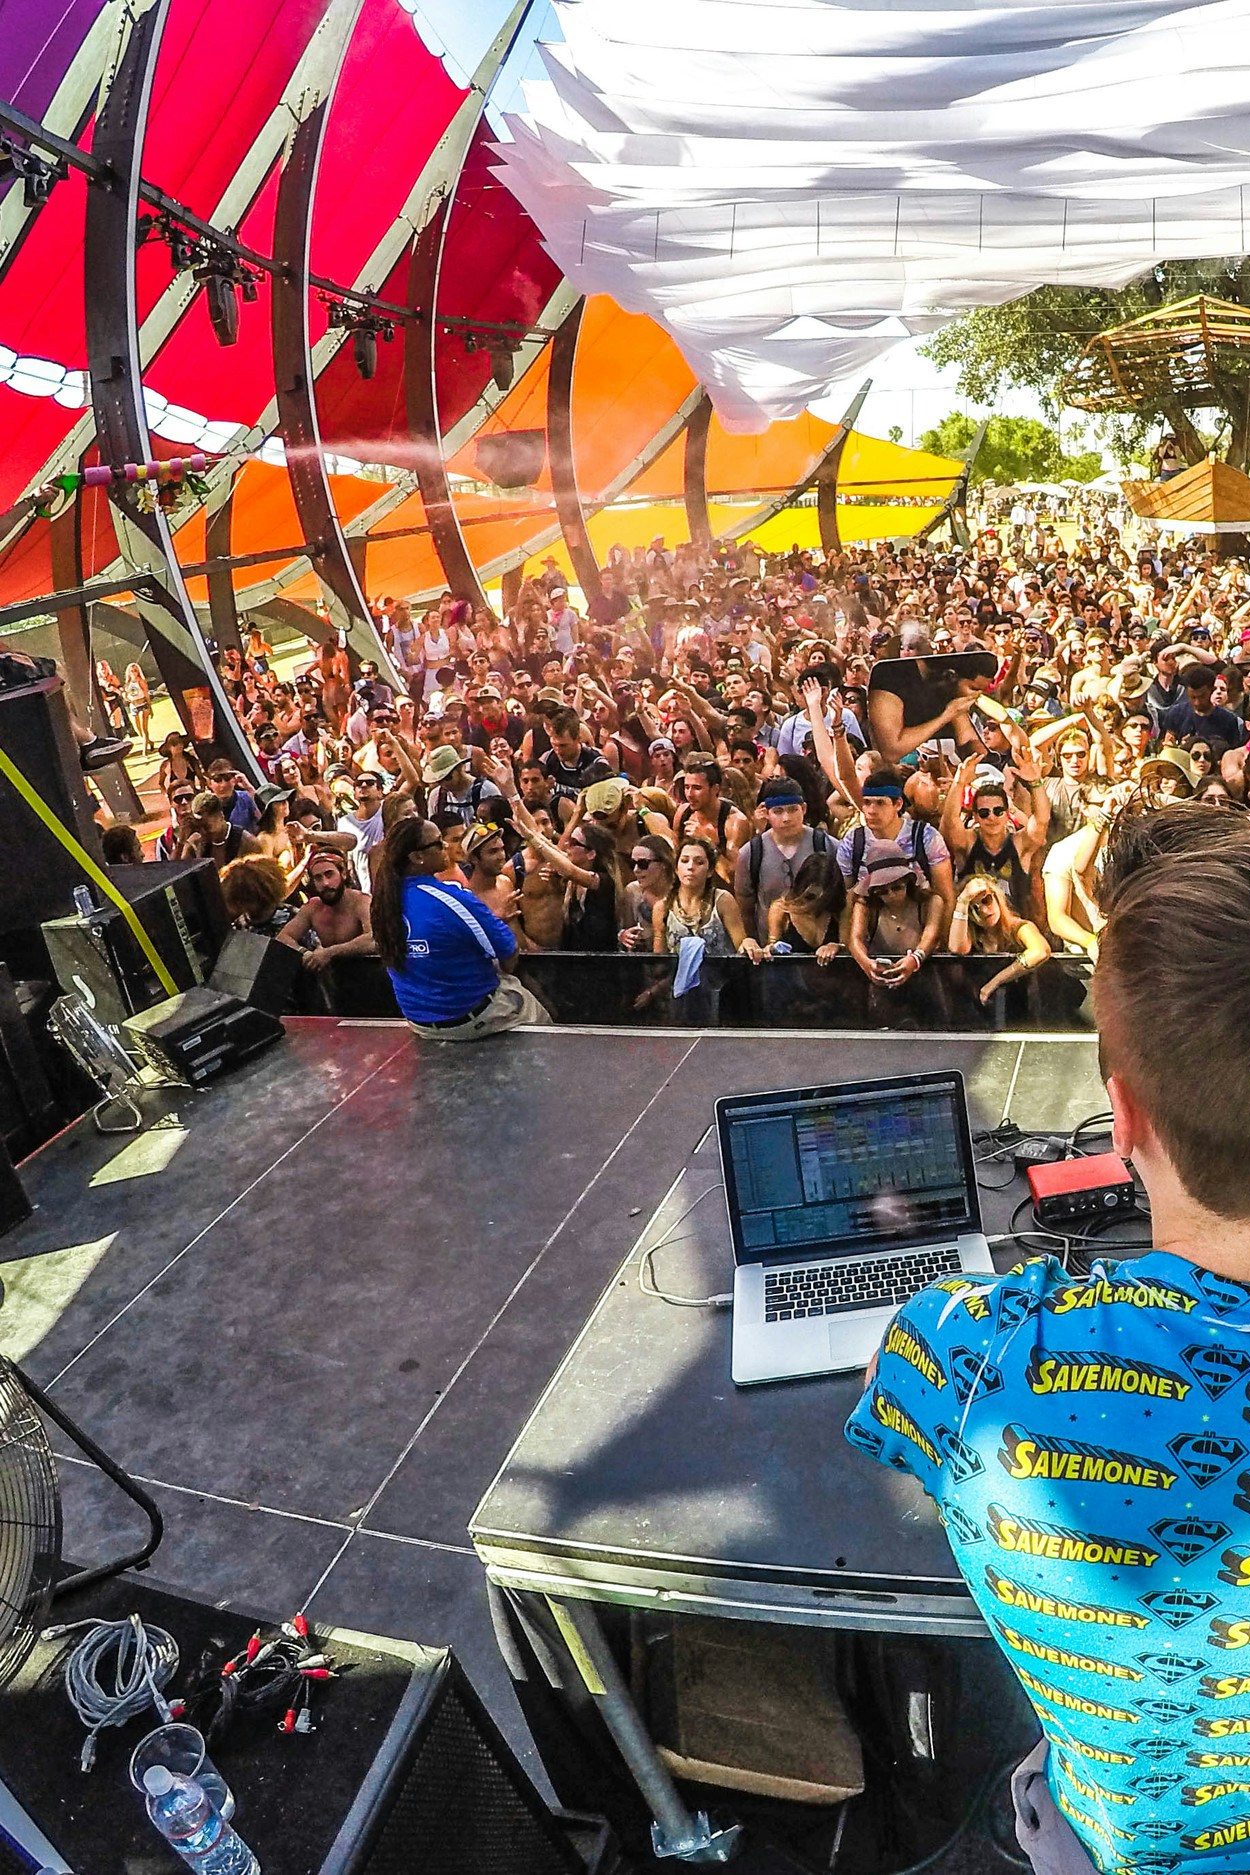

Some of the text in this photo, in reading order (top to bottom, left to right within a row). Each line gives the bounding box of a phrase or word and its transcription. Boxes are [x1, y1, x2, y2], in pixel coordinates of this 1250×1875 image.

[885, 1322, 948, 1391] SAVEMONEY
[1031, 1359, 1191, 1401] SAVEMONEY
[1008, 1440, 1179, 1490] SAVEMONEY
[997, 1520, 1160, 1568] SAVEMONEY
[994, 1578, 1151, 1630] SAVEMONEY
[1004, 1629, 1146, 1683] SAVEMONEY
[1018, 1667, 1141, 1725] SAVEMONEY
